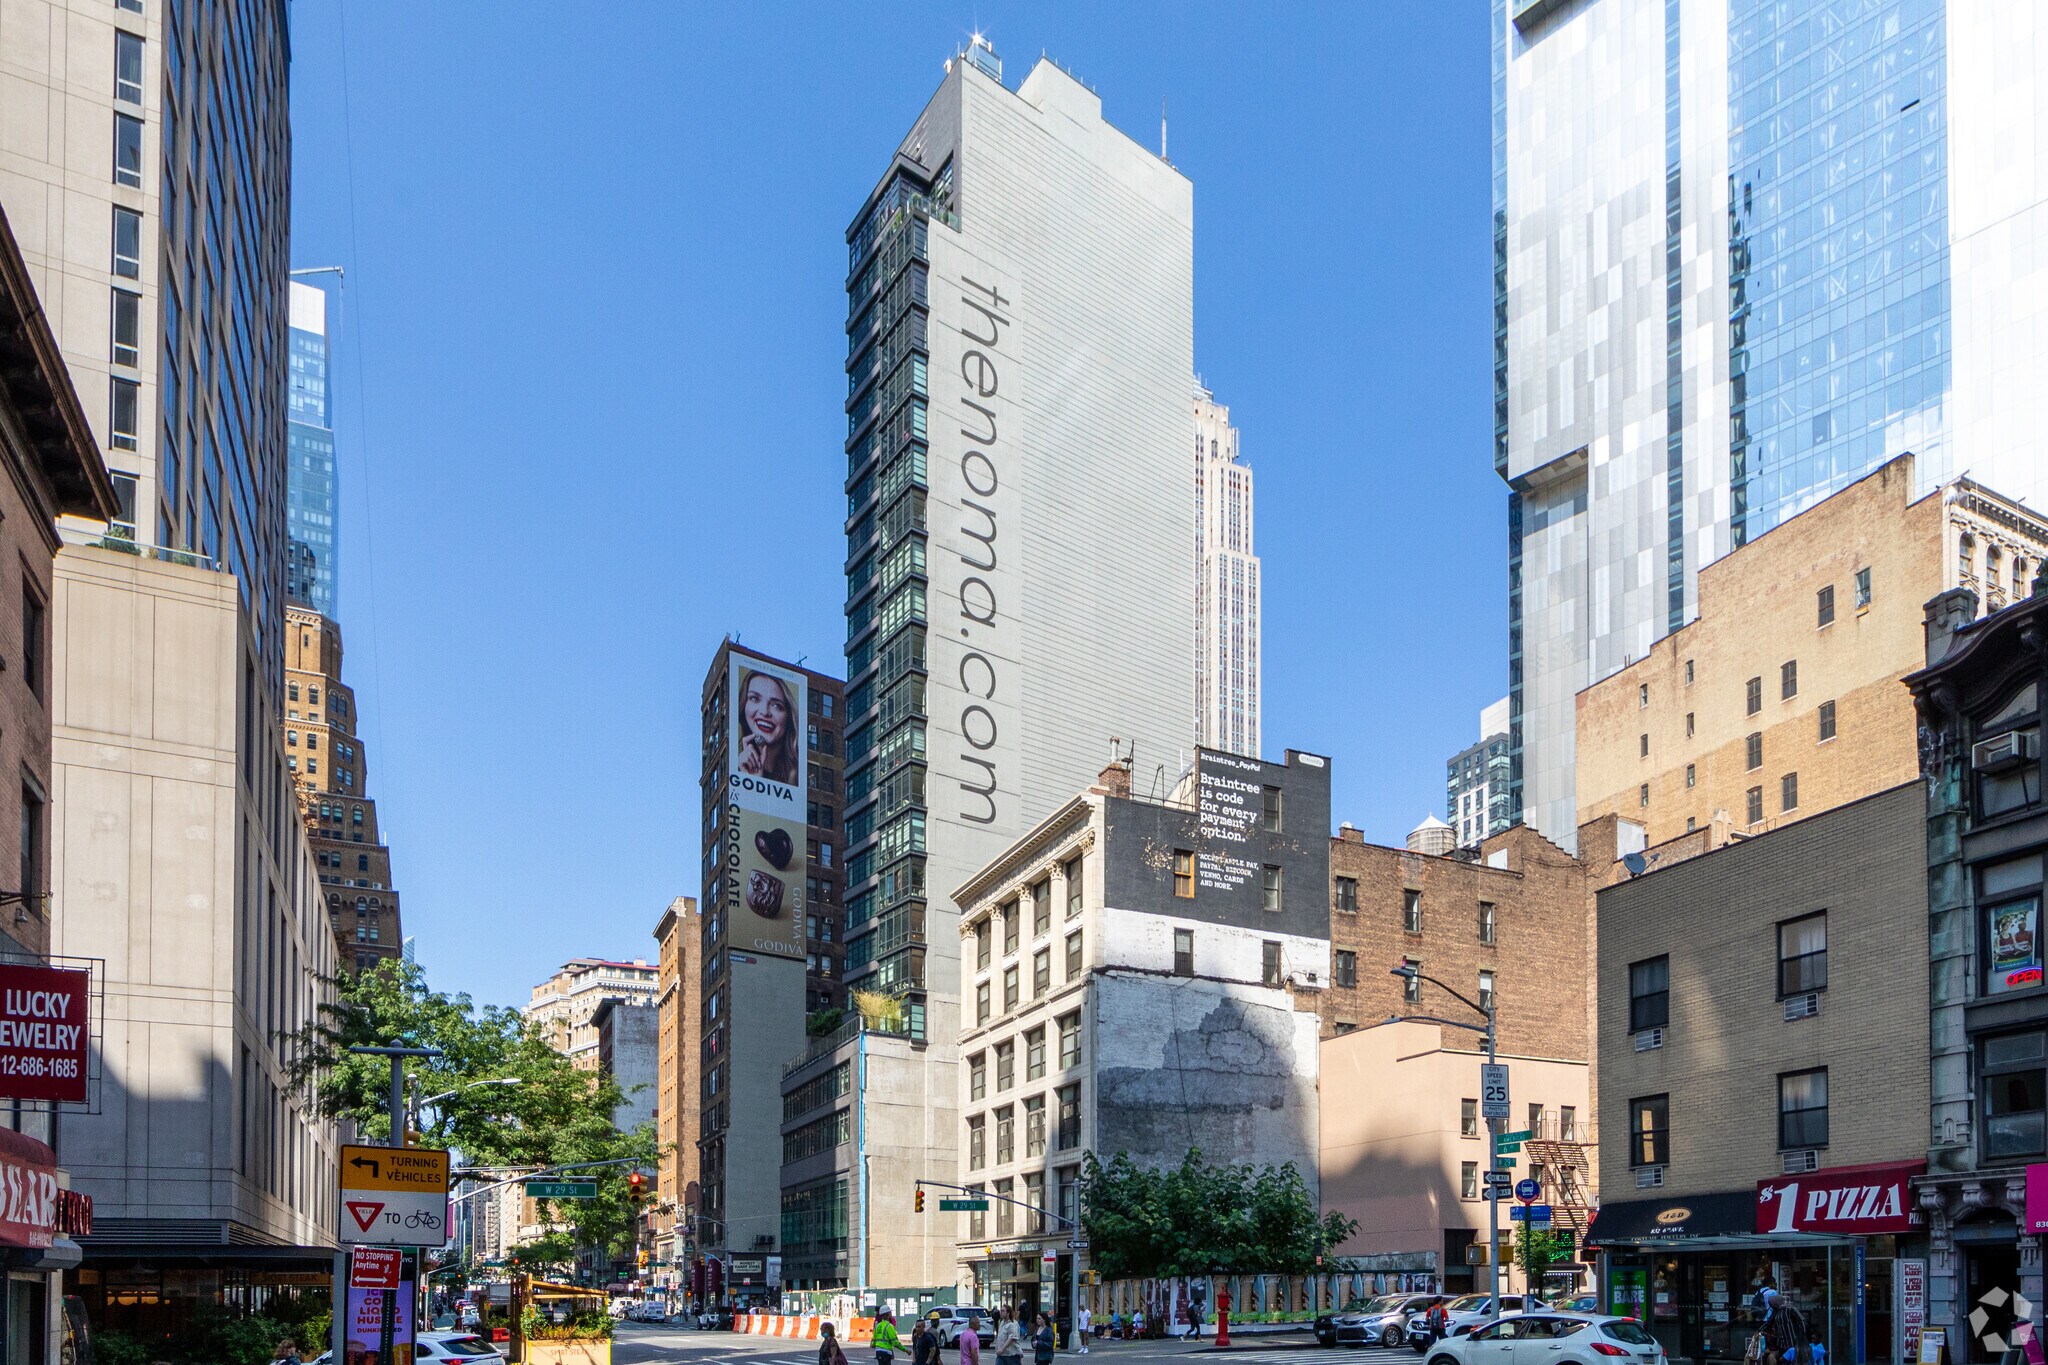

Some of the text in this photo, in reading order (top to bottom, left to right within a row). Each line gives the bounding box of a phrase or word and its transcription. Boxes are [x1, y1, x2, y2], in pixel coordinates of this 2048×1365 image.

[960, 275, 1010, 825] thenoma.com
[729, 774, 793, 801] GODIVA
[1200, 772, 1260, 794] Braintree
[729, 788, 740, 801] is
[1200, 786, 1244, 805] is code
[1200, 799, 1257, 823] for every
[1200, 811, 1246, 829] payment
[1200, 826, 1246, 843] option.
[728, 803, 741, 908] CHOCOLATE
[1200, 862, 1224, 872] PAYPAL,
[1246, 861, 1259, 870] PAY,
[1200, 871, 1244, 884] VENMO, CARDS
[1200, 879, 1233, 890] AND MORE.
[754, 938, 803, 955] GODIVA
[2006, 969, 2042, 986] OPEN
[6, 989, 71, 1019] LUCKY
[1486, 1086, 1506, 1101] 25
[390, 1157, 439, 1168] TURNING
[1504, 1158, 1511, 1166] 29
[387, 1171, 441, 1183] VEHICLES
[545, 1186, 577, 1194] W 29 St
[1804, 1183, 1904, 1222] PIZZA
[384, 1212, 401, 1224] TO
[356, 1252, 394, 1261] NO STOPPING
[355, 1261, 380, 1270] Anytime
[1614, 1290, 1644, 1304] BARE
[1905, 1326, 1920, 1337] PIZZ
